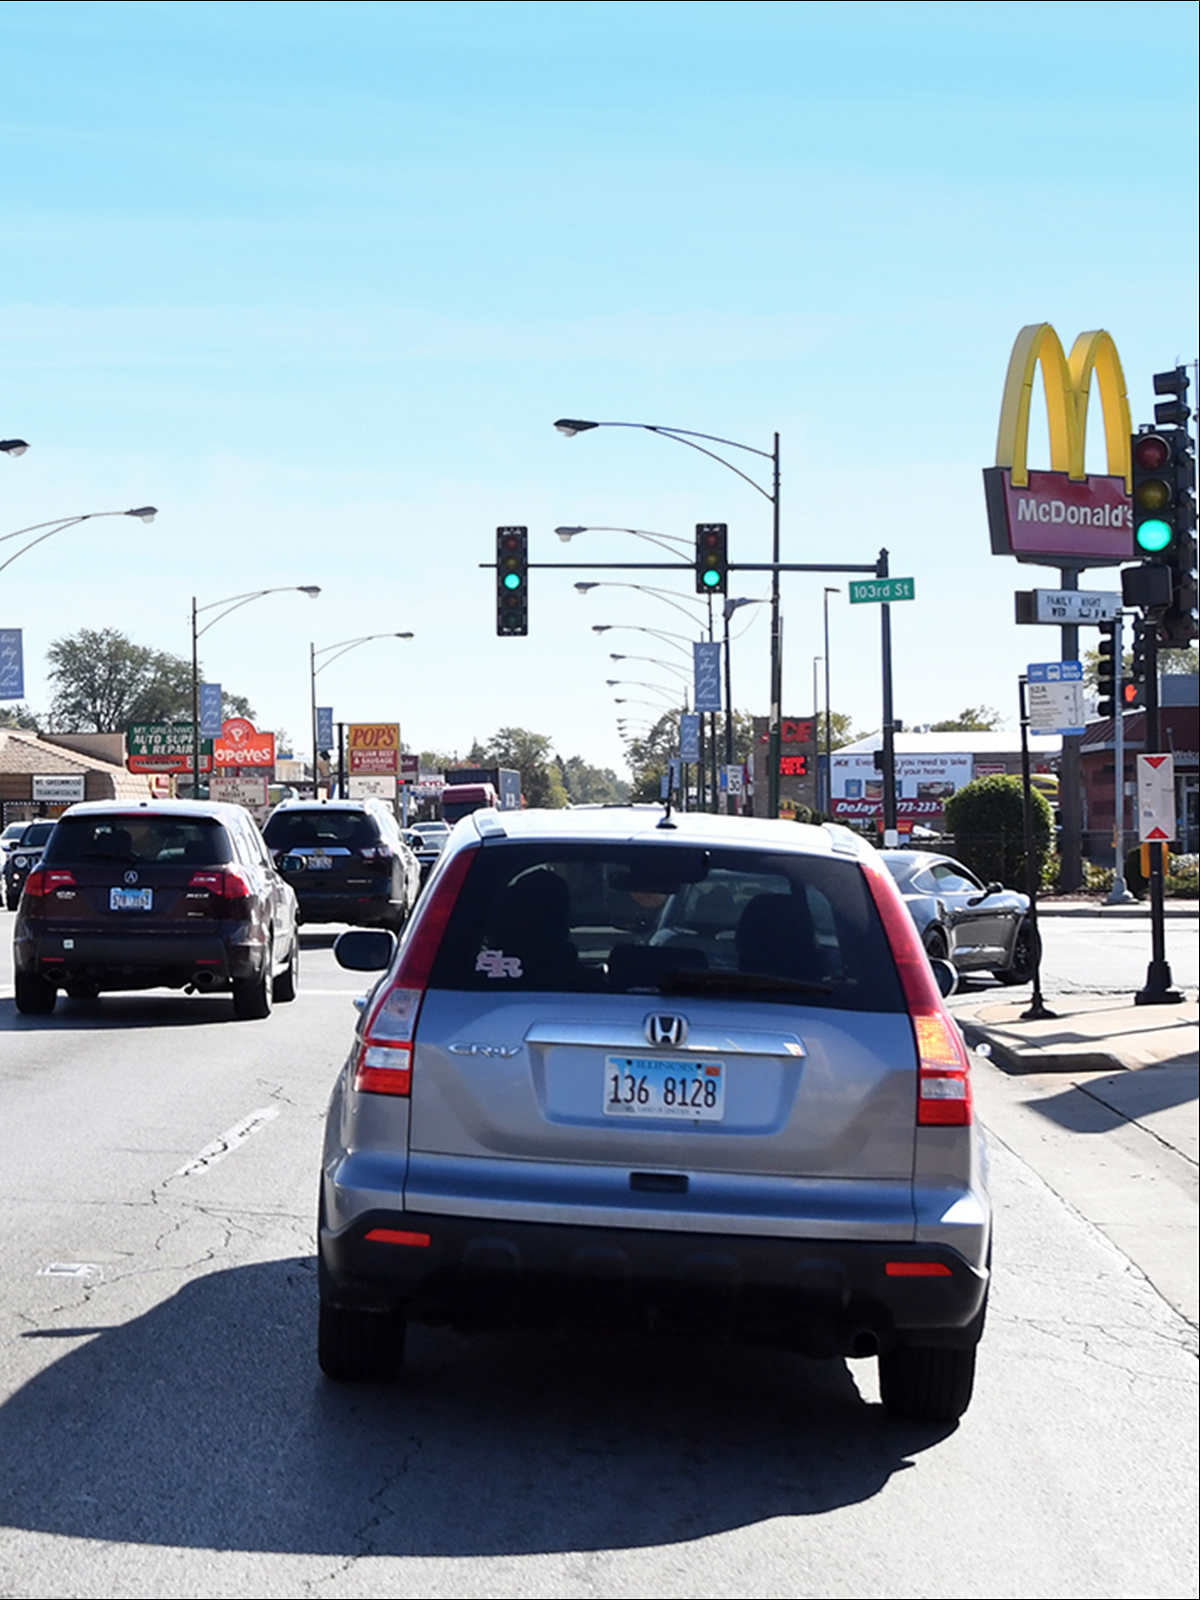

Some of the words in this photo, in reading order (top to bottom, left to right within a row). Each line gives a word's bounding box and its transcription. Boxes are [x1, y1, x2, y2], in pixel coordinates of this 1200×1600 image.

[1017, 497, 1133, 528] McDonald's
[854, 585, 891, 599] 103rd
[894, 583, 909, 596] St
[133, 735, 162, 744] AUTO
[353, 726, 396, 747] POP'S
[153, 745, 194, 754] REPAIR
[917, 758, 937, 766] need
[940, 758, 948, 766] to
[903, 769, 921, 777] your
[730, 783, 740, 792] 30
[636, 1061, 694, 1072] ILLINOIS
[609, 1074, 650, 1105] 136
[663, 1076, 717, 1109] 8128
